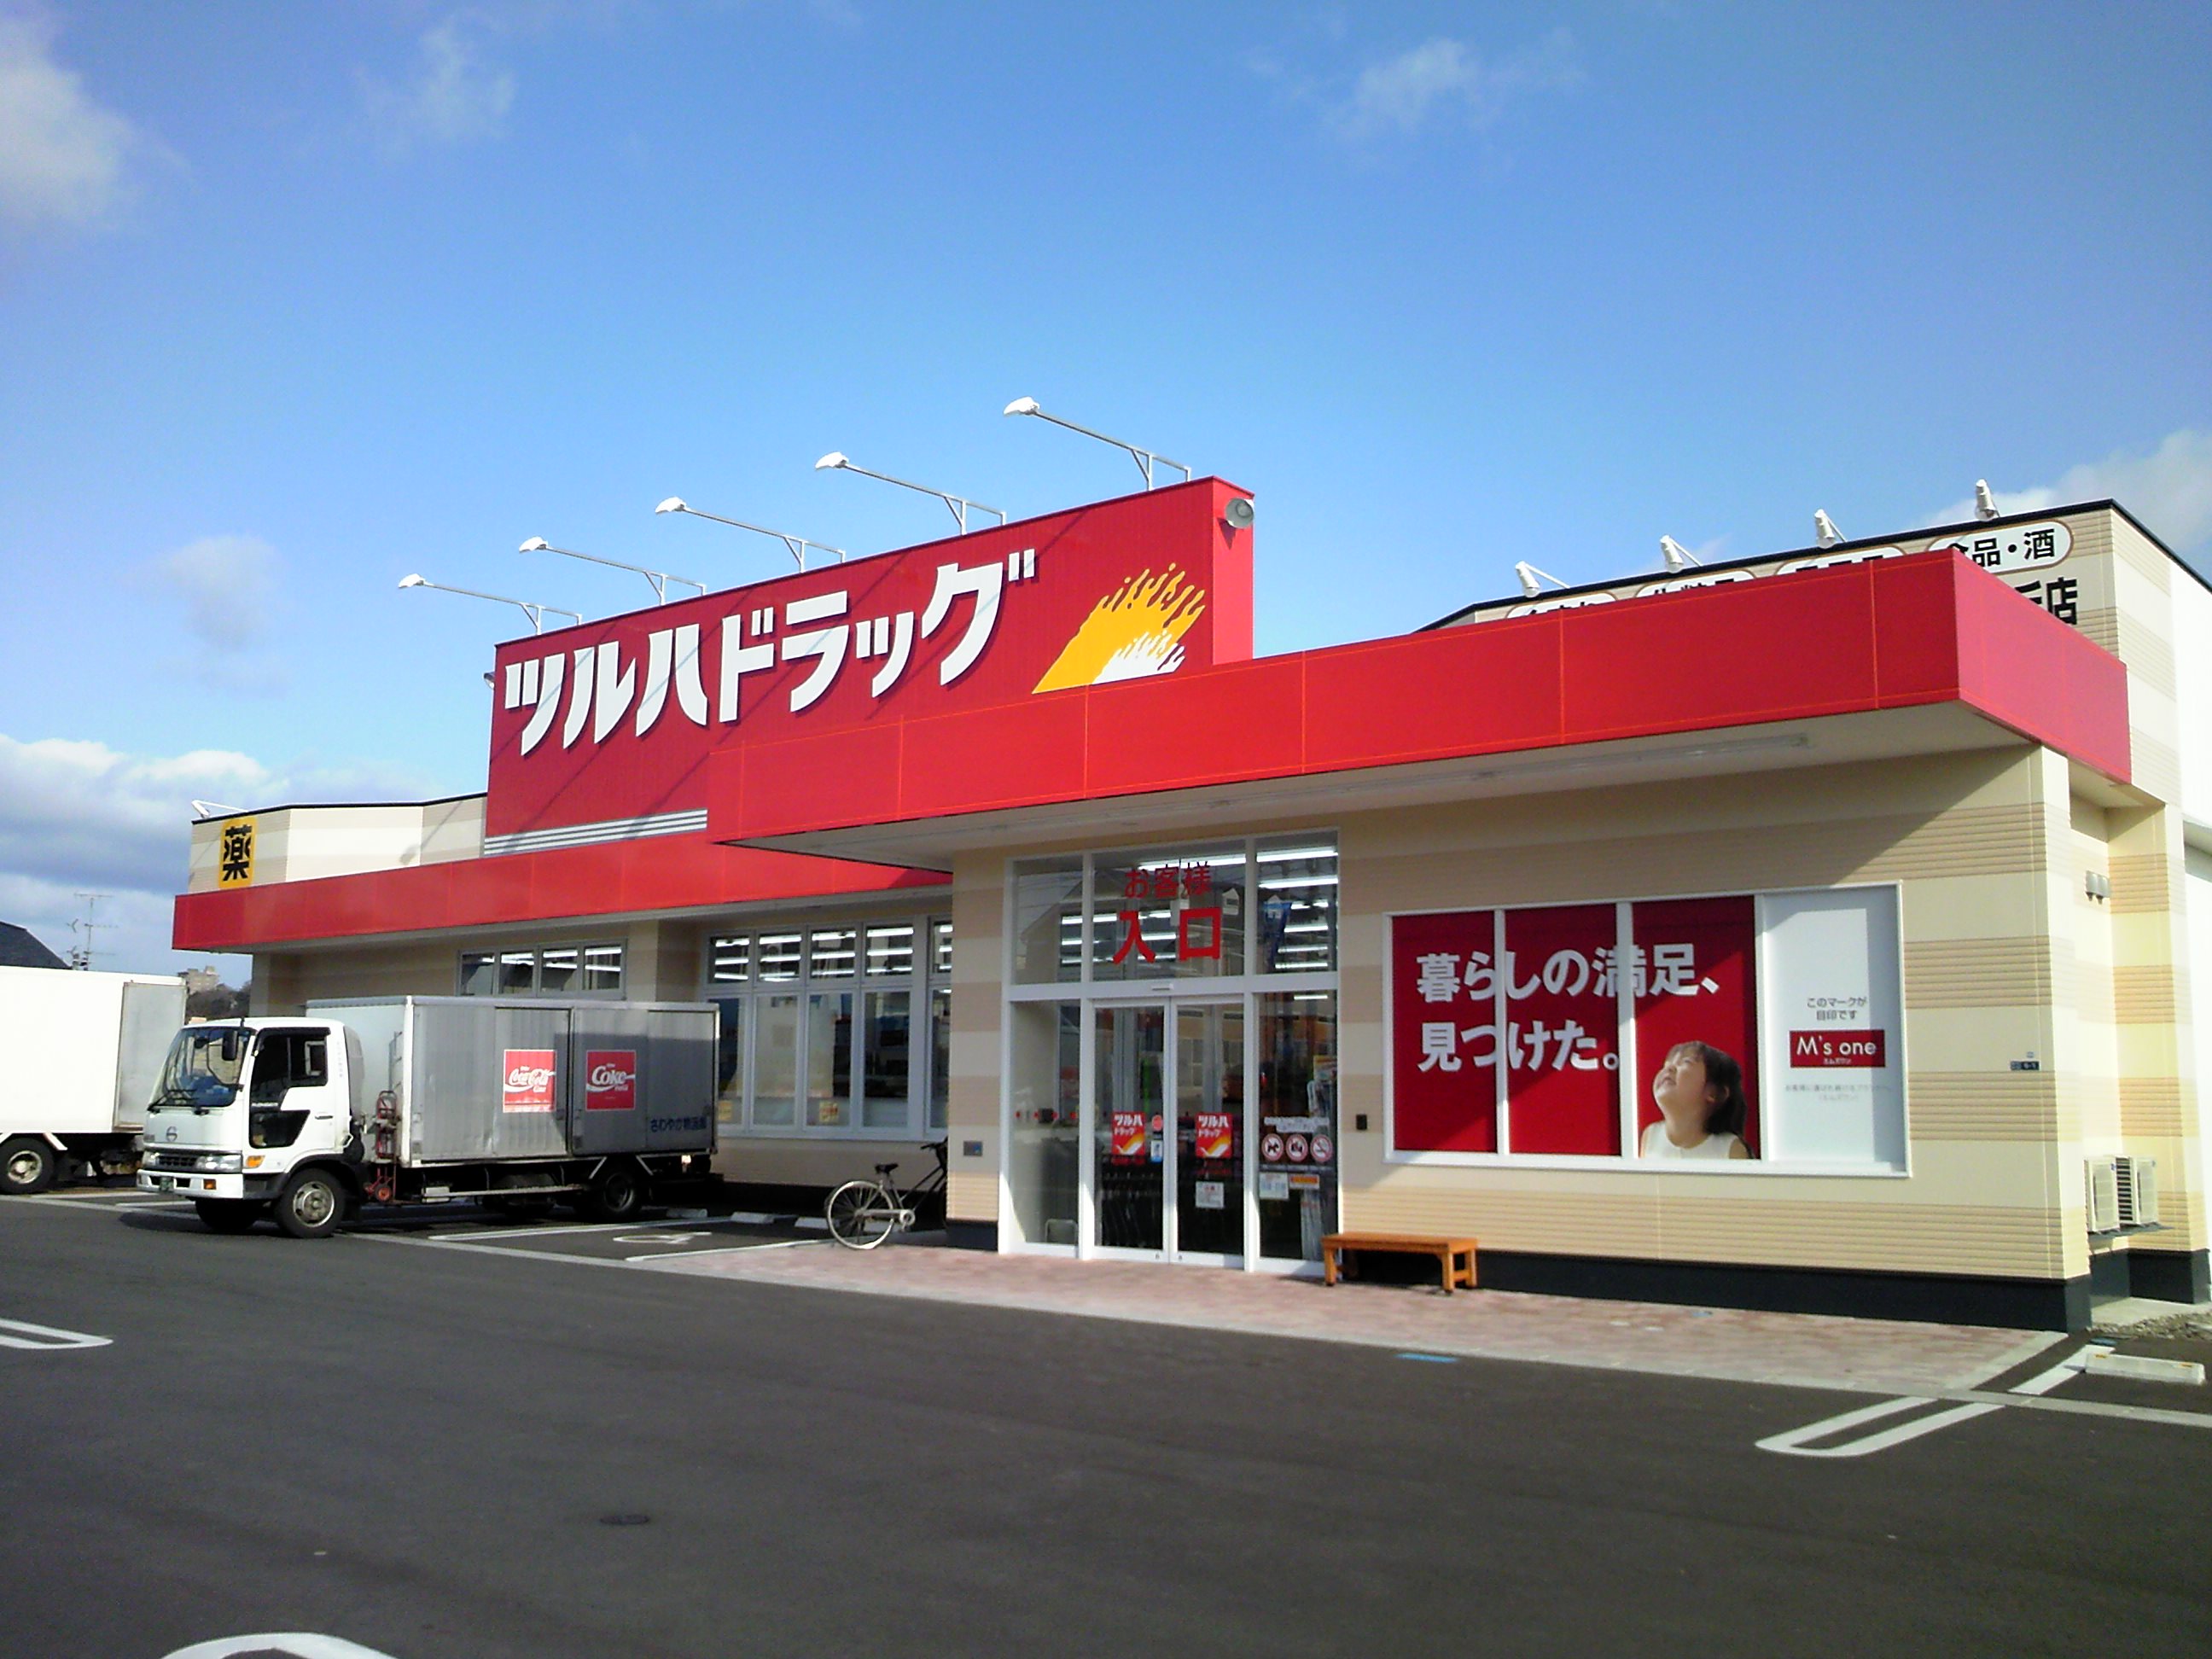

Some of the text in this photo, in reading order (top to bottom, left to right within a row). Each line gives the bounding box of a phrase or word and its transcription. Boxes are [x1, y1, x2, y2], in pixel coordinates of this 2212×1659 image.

[1947, 528, 2055, 568] 品・酒
[504, 549, 1035, 756] ツルハドラッグ
[223, 824, 253, 882] 薬
[1125, 861, 1212, 899] お客様
[1113, 906, 1223, 964] 入口
[1807, 997, 1867, 1008] このマークが
[1816, 1010, 1857, 1021] 目印です
[1796, 1035, 1877, 1056] M's one
[592, 1066, 626, 1085] Coke
[1114, 1114, 1143, 1126] ツルハ
[1198, 1115, 1229, 1127] ツルハ
